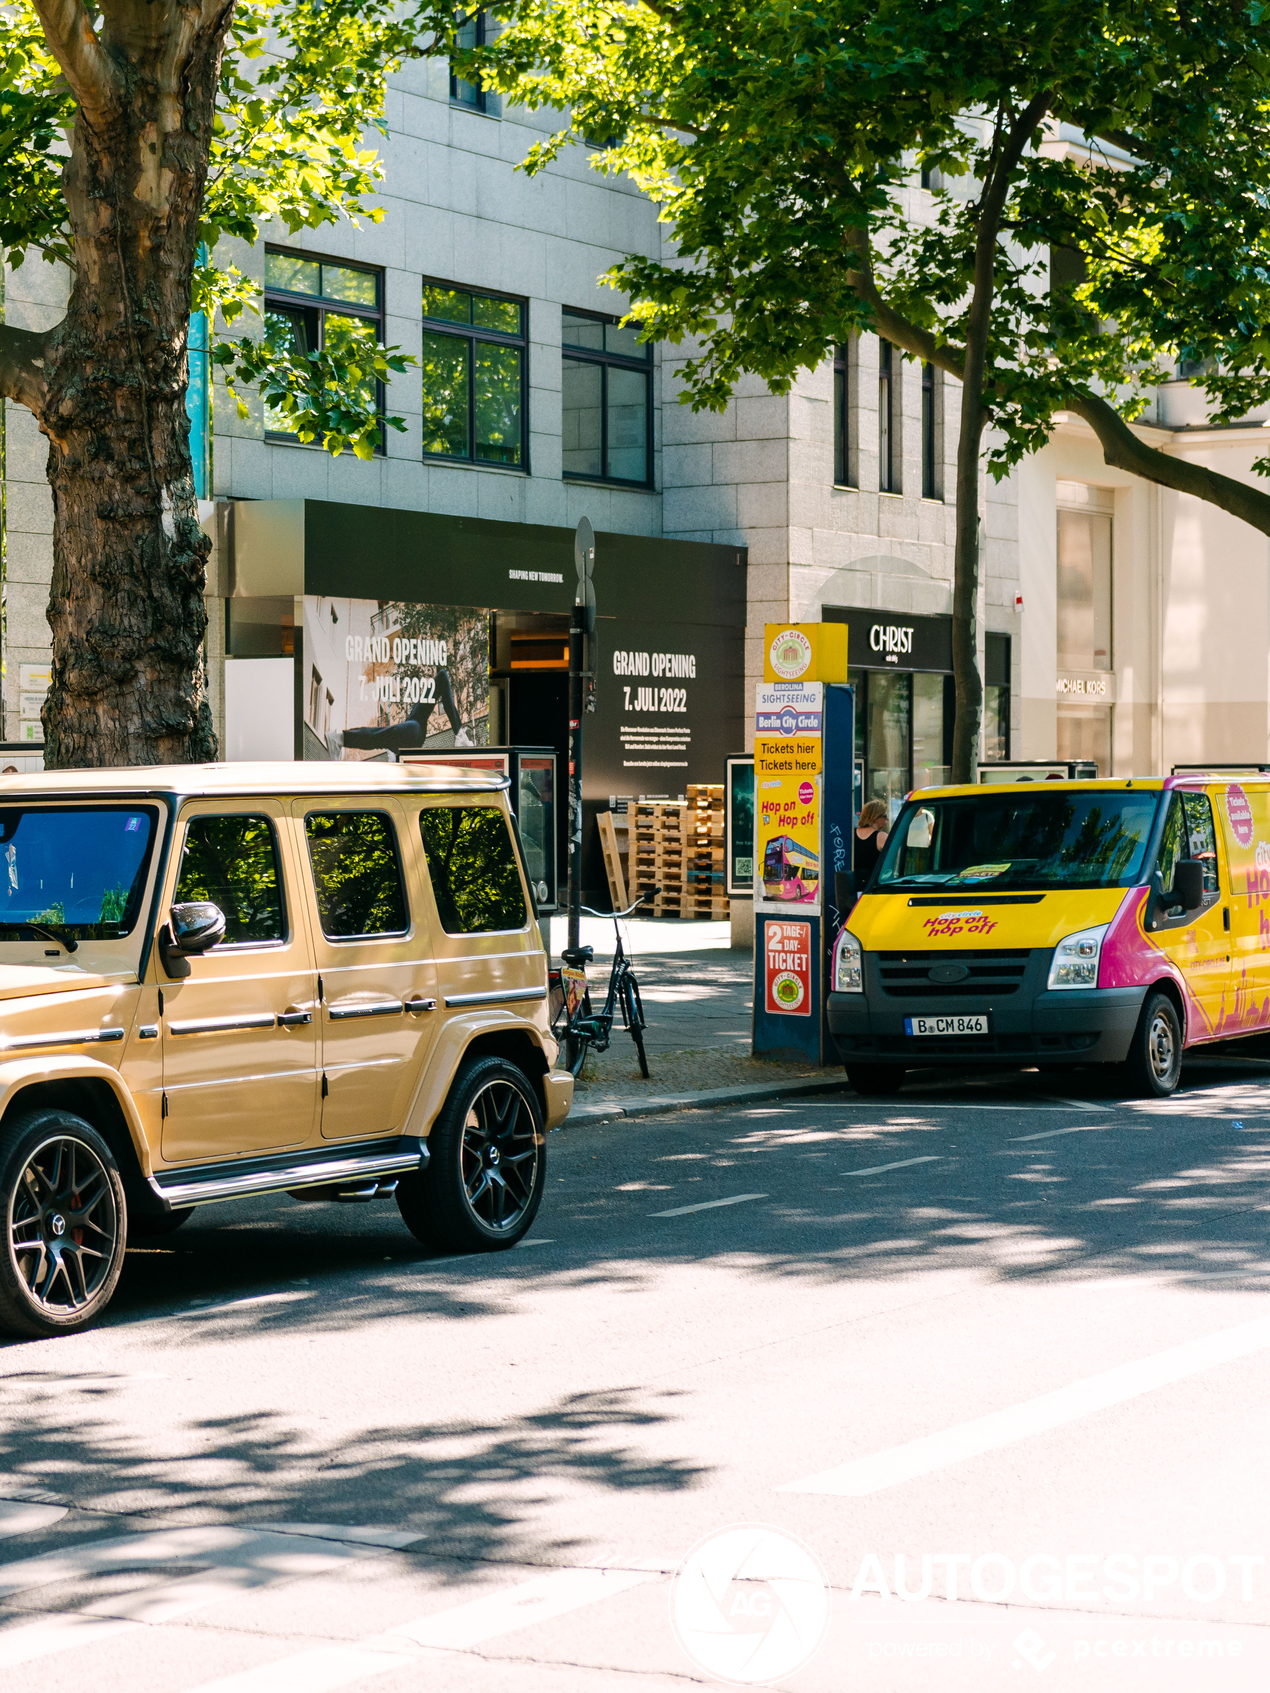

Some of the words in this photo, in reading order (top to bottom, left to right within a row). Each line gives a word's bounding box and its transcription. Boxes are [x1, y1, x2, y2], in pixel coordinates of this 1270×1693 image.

[509, 569, 528, 580] SHAPING
[529, 571, 538, 581] NEW
[772, 631, 810, 651] CITY-CIRCLE
[870, 624, 914, 654] CHRIST
[345, 635, 390, 663] GRAND
[393, 637, 447, 666] OPENING
[613, 650, 650, 676] GRAND
[651, 652, 696, 678] OPENING
[773, 662, 807, 677] SIGHTSEEING
[358, 675, 368, 701] 7.
[372, 675, 400, 703] JULI
[403, 677, 436, 704] 2022
[1056, 679, 1085, 693] MICHAEL
[1087, 680, 1106, 695] KORS
[623, 686, 633, 711] 7.
[634, 687, 658, 711] JULI
[659, 688, 687, 712] 2022
[762, 693, 816, 703] SIGHTSEEING
[758, 715, 781, 728] Berlin
[782, 715, 797, 730] City
[798, 715, 818, 728] Circle
[761, 743, 794, 754] Tickets
[797, 743, 815, 754] hier
[759, 759, 792, 770] Tickets
[795, 759, 816, 770] here
[761, 801, 781, 815] Hop
[783, 801, 796, 811] on
[1229, 797, 1246, 806] Tickets
[778, 815, 798, 829] Hop
[800, 811, 815, 826] off
[922, 917, 961, 928] Hop
[965, 916, 989, 924] on
[927, 926, 963, 937] hop
[967, 921, 998, 934] off
[768, 925, 782, 950] 2
[784, 939, 801, 951] DAY-
[768, 952, 807, 971] TICKET
[918, 1020, 927, 1033] B
[936, 1018, 954, 1032] CM
[957, 1018, 982, 1032] 846
